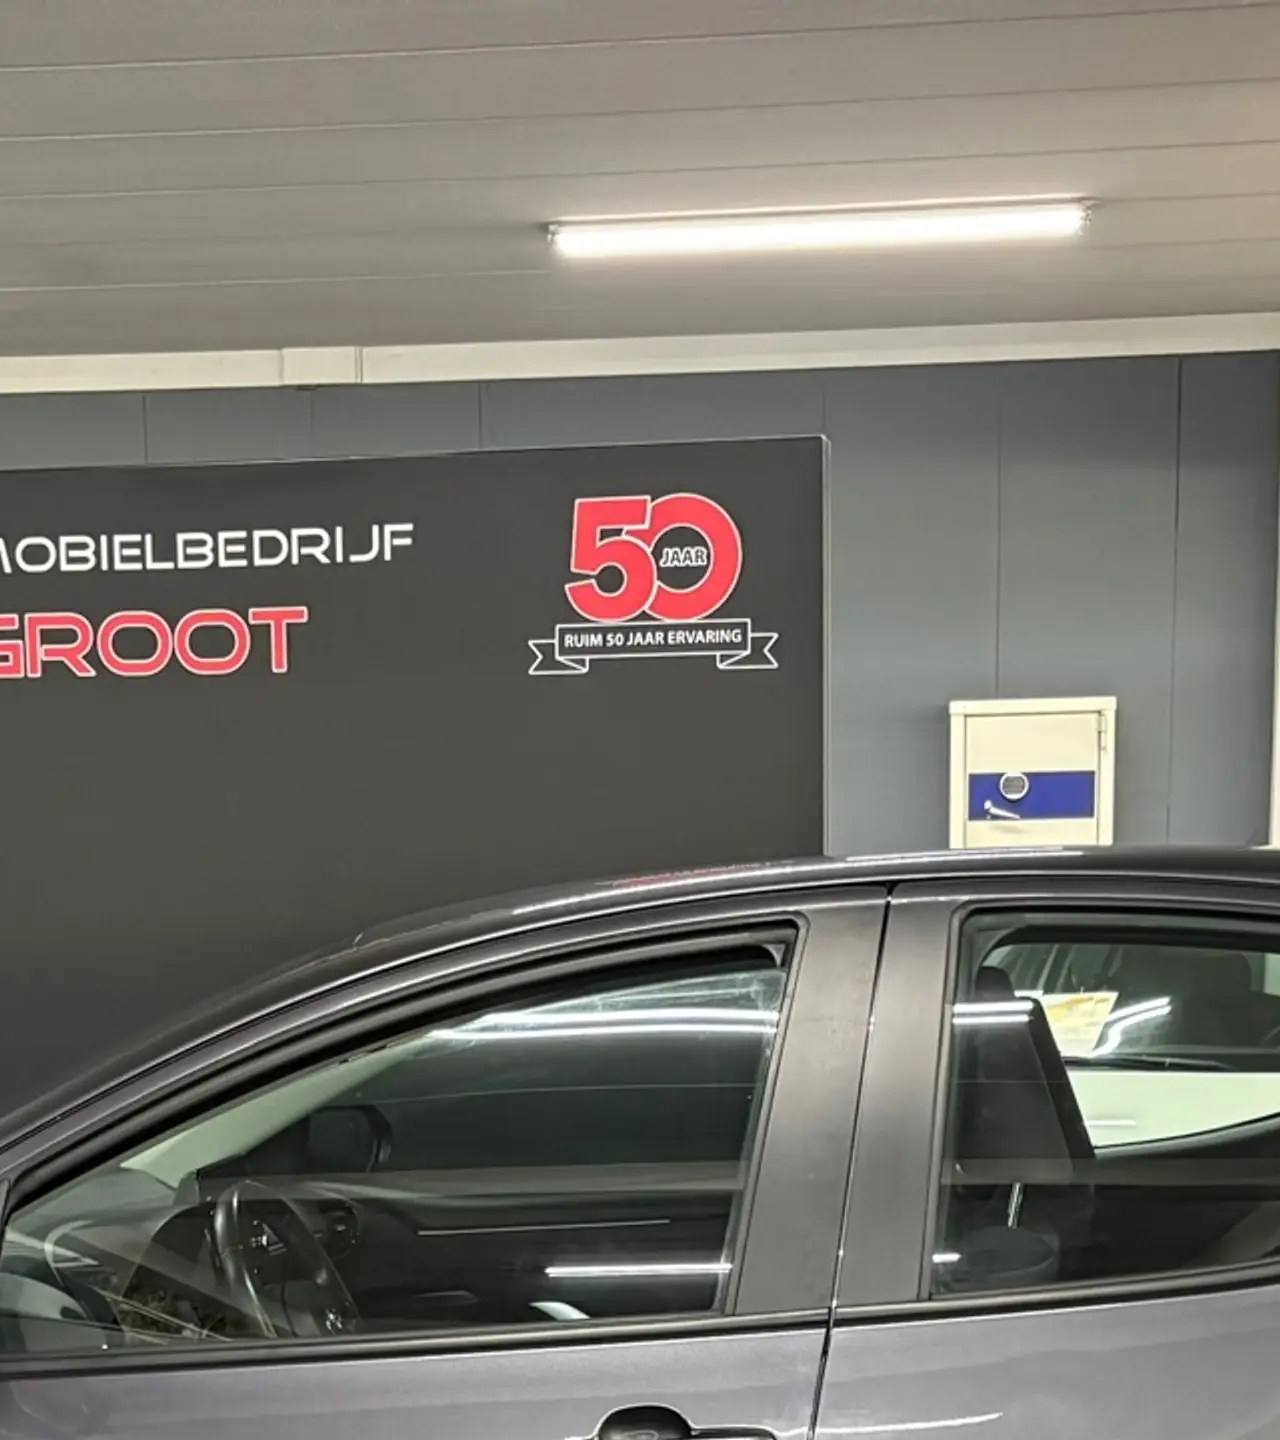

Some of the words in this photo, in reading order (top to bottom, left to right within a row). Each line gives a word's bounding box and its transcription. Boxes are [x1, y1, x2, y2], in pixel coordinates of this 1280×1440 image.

[564, 492, 743, 622] 50
[659, 546, 708, 568] JAAR
[564, 632, 603, 648] RUIM
[606, 632, 625, 647] 50
[626, 630, 665, 646] JAAR
[667, 629, 742, 645] ERVARING
